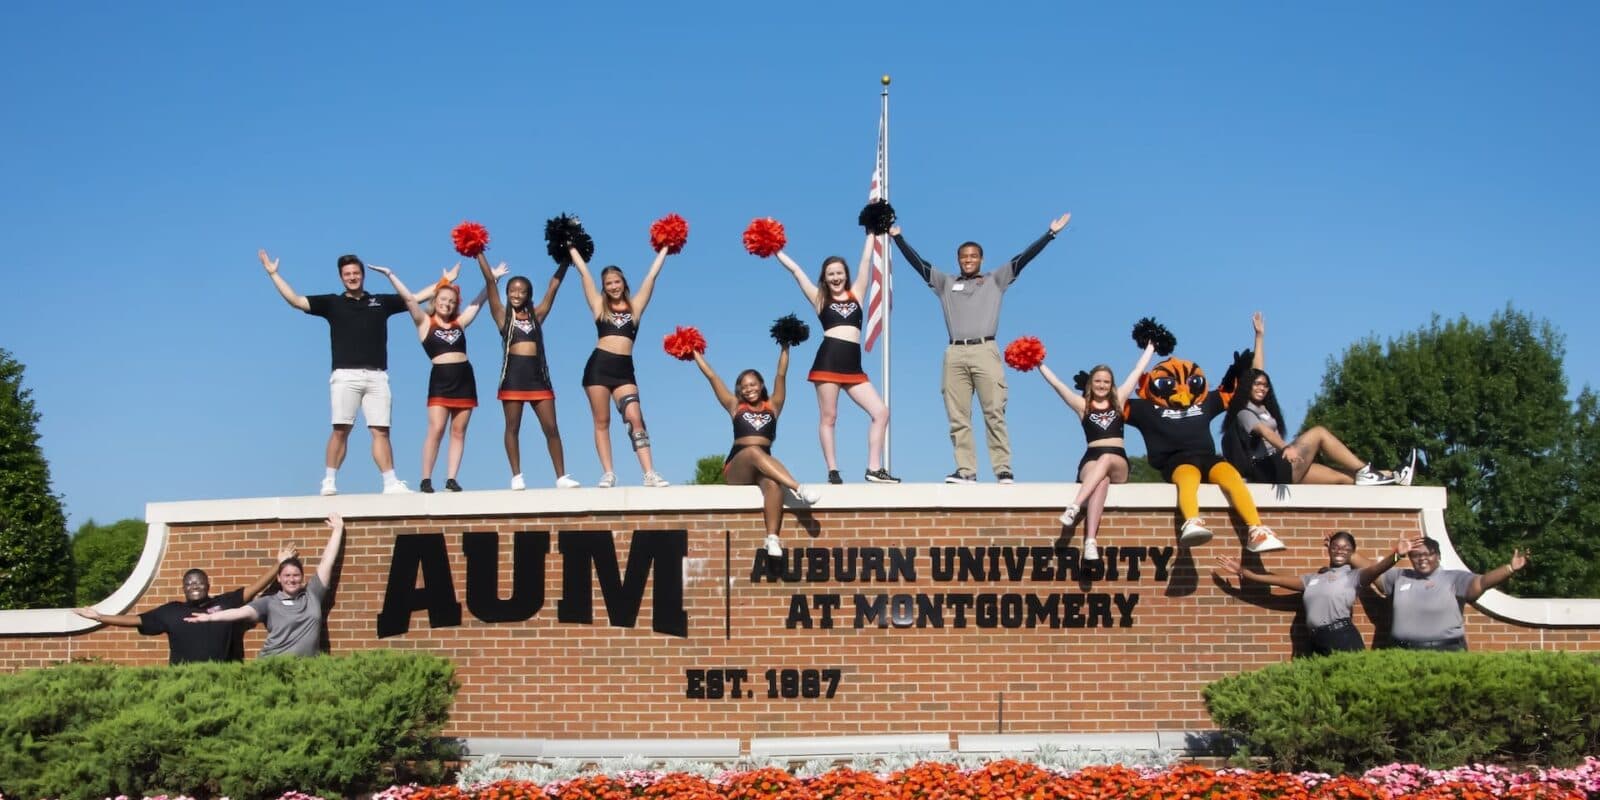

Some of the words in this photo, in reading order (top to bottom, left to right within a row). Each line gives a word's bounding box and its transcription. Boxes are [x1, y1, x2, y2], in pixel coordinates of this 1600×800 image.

[751, 547, 917, 582] AUBURN
[377, 530, 688, 639] AUM
[786, 594, 840, 629] AT
[853, 593, 1139, 629] MONTGOMERY
[686, 669, 753, 699] EST.
